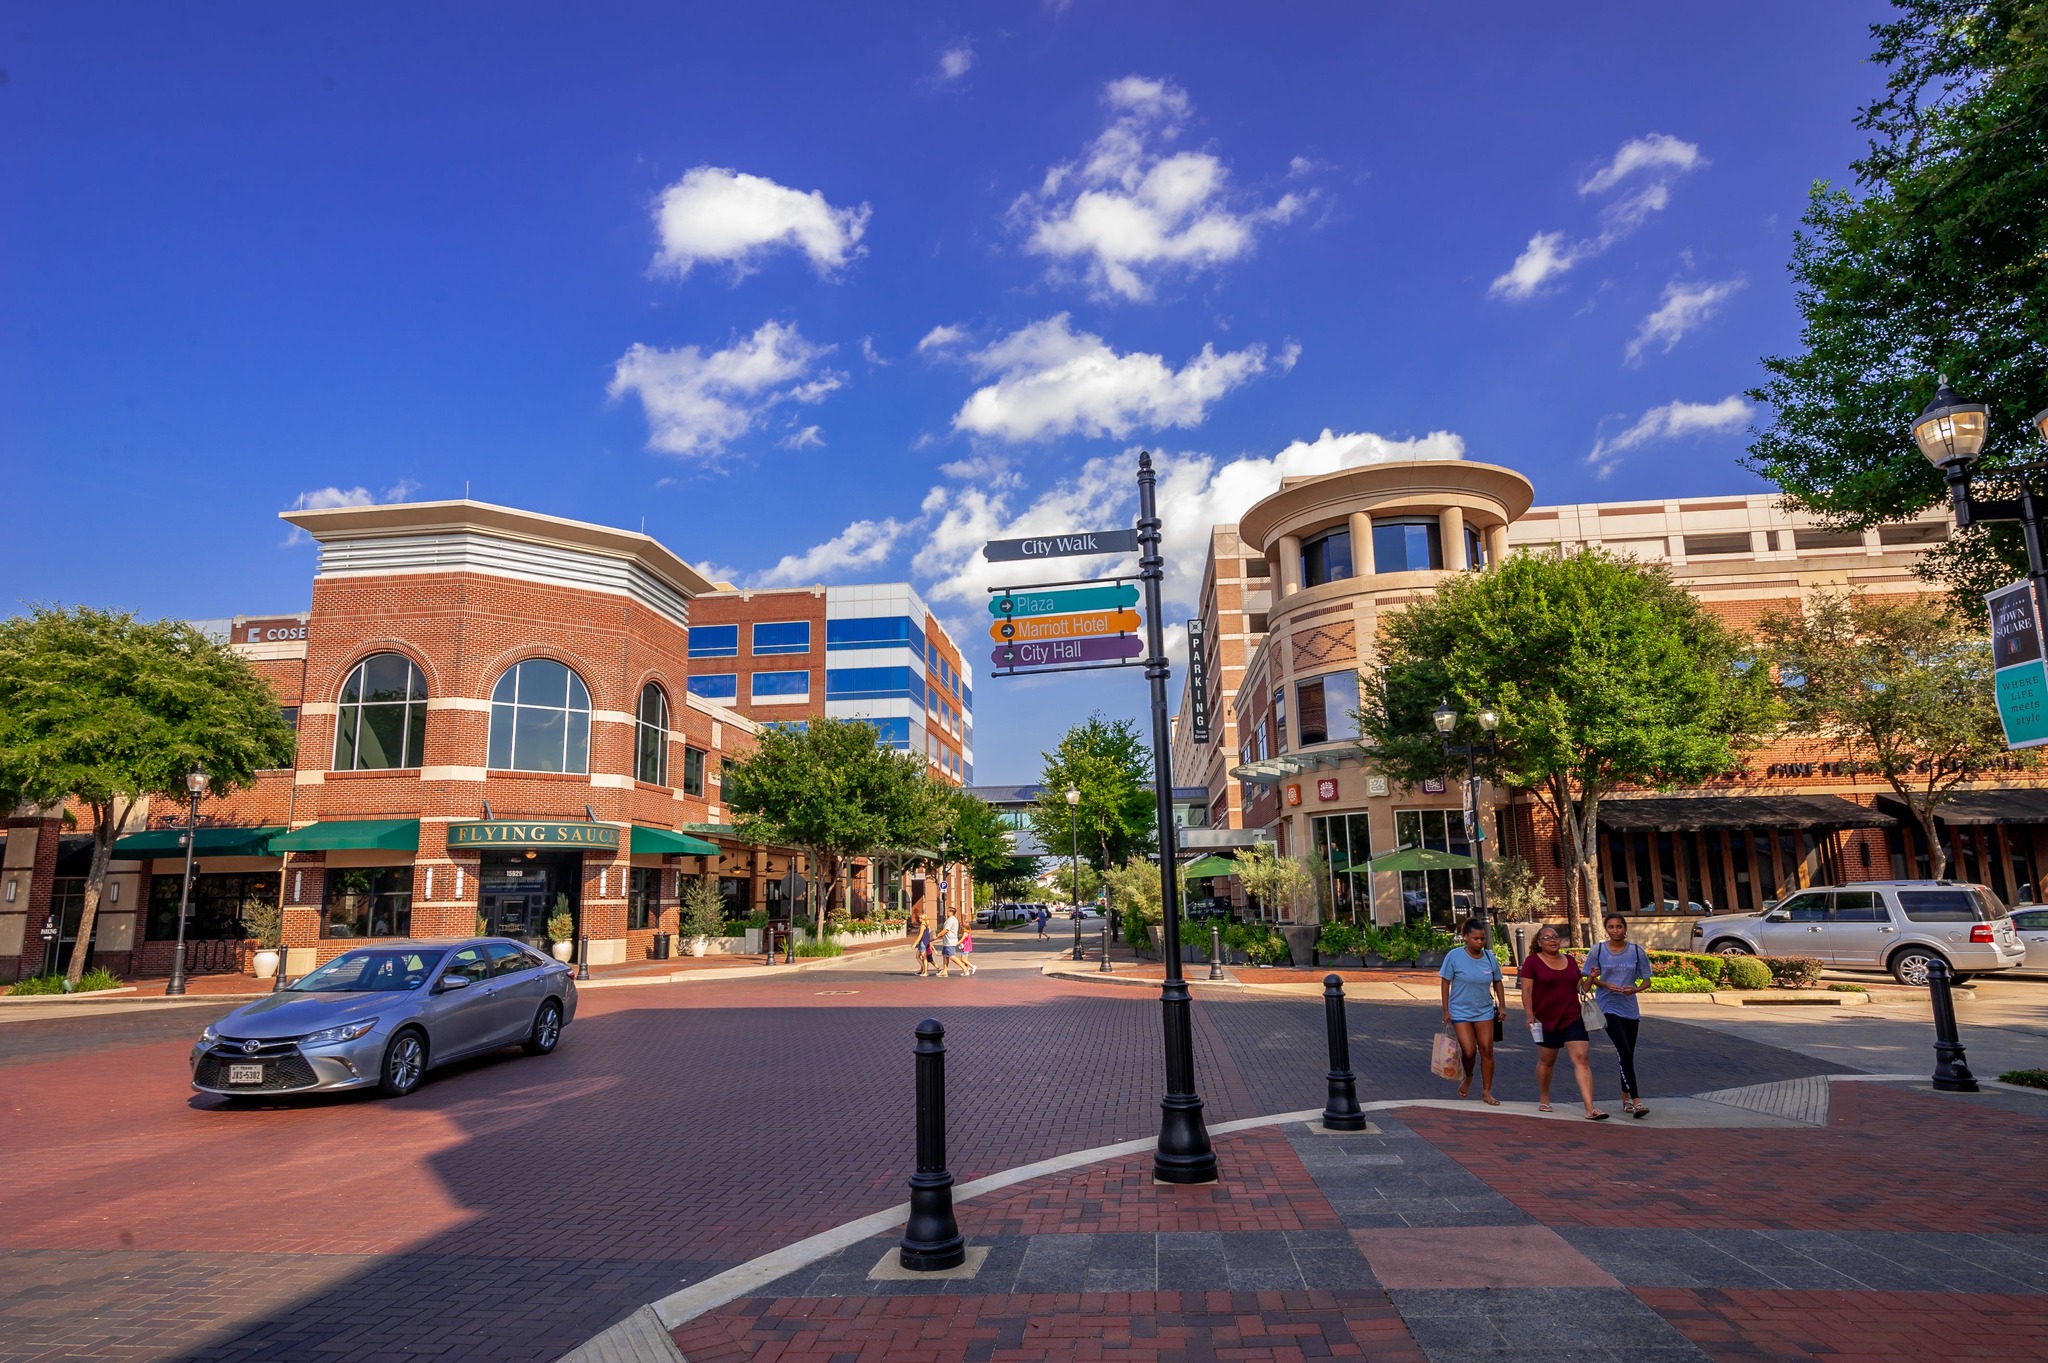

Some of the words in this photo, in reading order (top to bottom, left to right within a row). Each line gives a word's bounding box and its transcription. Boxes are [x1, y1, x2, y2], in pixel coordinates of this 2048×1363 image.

[1021, 538, 1052, 556] City
[1056, 535, 1098, 552] Walk
[1017, 597, 1054, 613] Plaza
[1999, 607, 2025, 625] TOWN
[266, 626, 310, 641] COSE
[1018, 619, 1069, 638] Marriott
[1073, 616, 1109, 634] Hotel
[1996, 617, 2032, 638] SQUARE
[1020, 644, 1049, 664] City
[1053, 641, 1081, 659] Hall
[1192, 638, 1205, 727] PARKING
[2002, 676, 2039, 691] WHERE
[2011, 689, 2034, 701] LIFE
[2011, 700, 2041, 713] meets
[2016, 714, 2041, 727] style
[458, 825, 547, 842] FLYING
